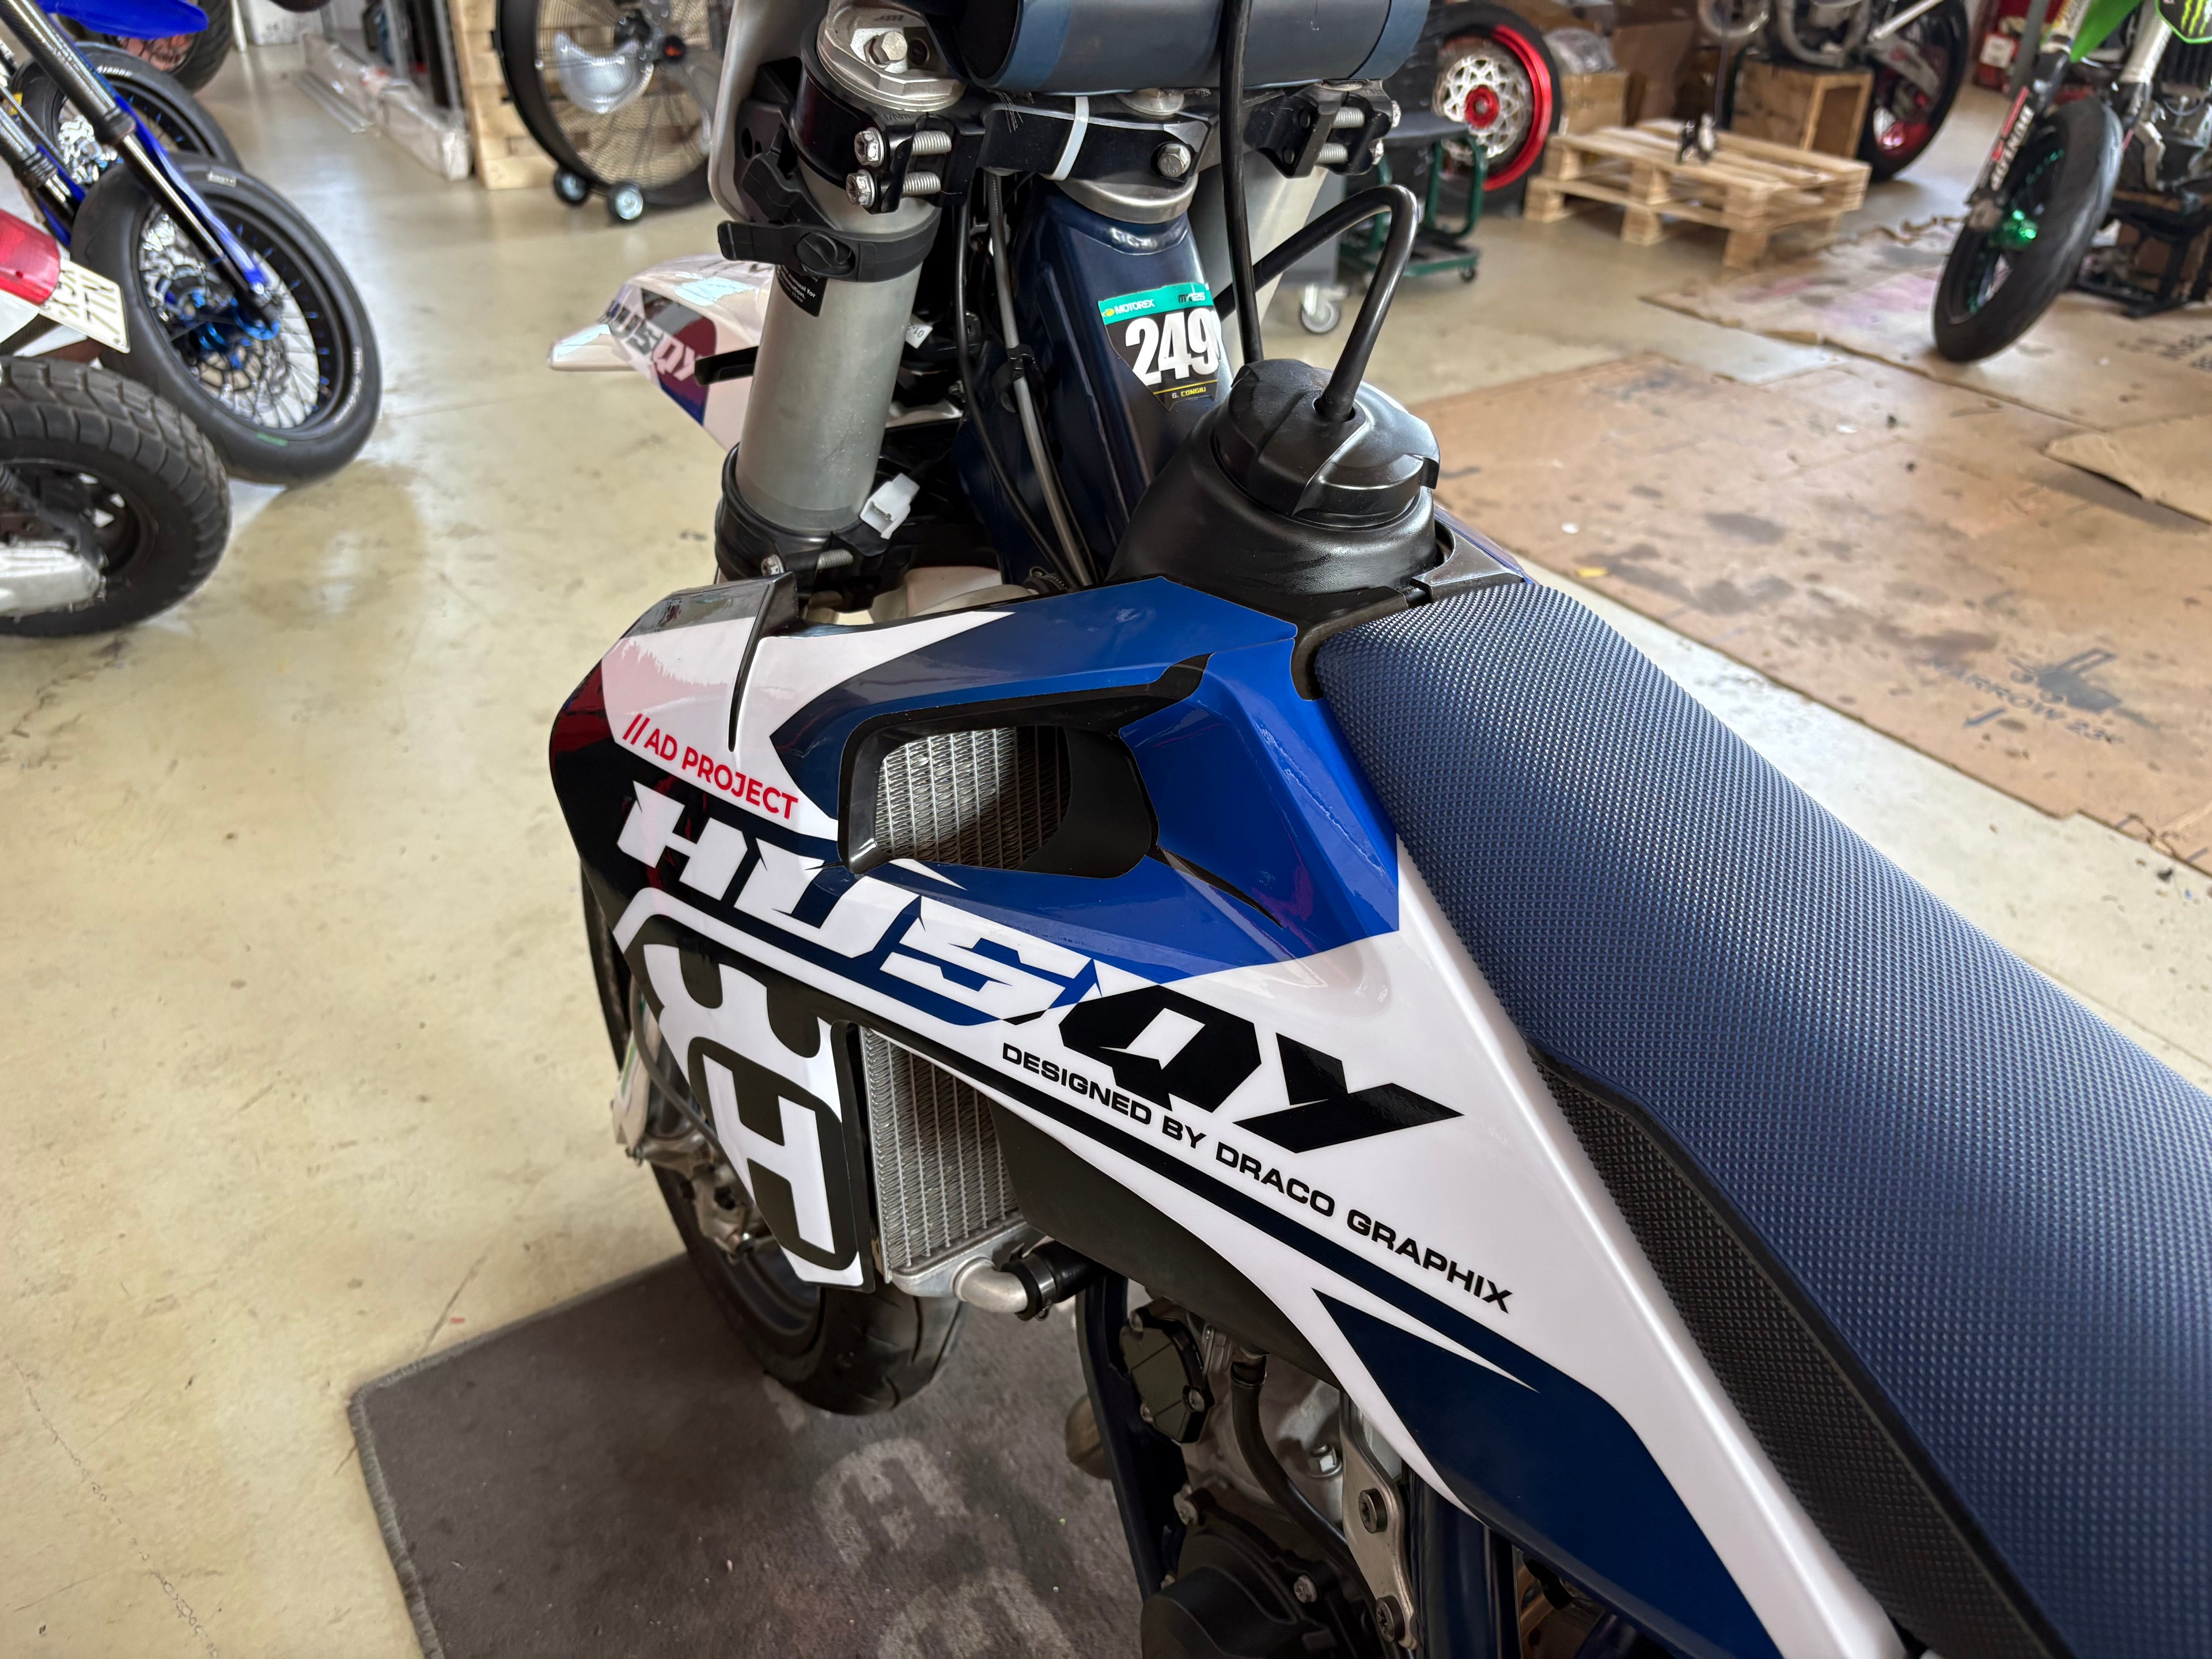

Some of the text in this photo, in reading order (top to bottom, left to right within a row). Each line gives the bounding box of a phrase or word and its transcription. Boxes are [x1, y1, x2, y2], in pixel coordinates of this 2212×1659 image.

[807, 289, 816, 298] for
[1115, 299, 1155, 315] MOTOREX
[1125, 308, 1220, 387] 249
[1180, 387, 1206, 397] CONGIU
[681, 746, 799, 820] PROJECT
[1002, 1042, 1515, 1314] DESIGNED BY DRACO GRAPHIX
